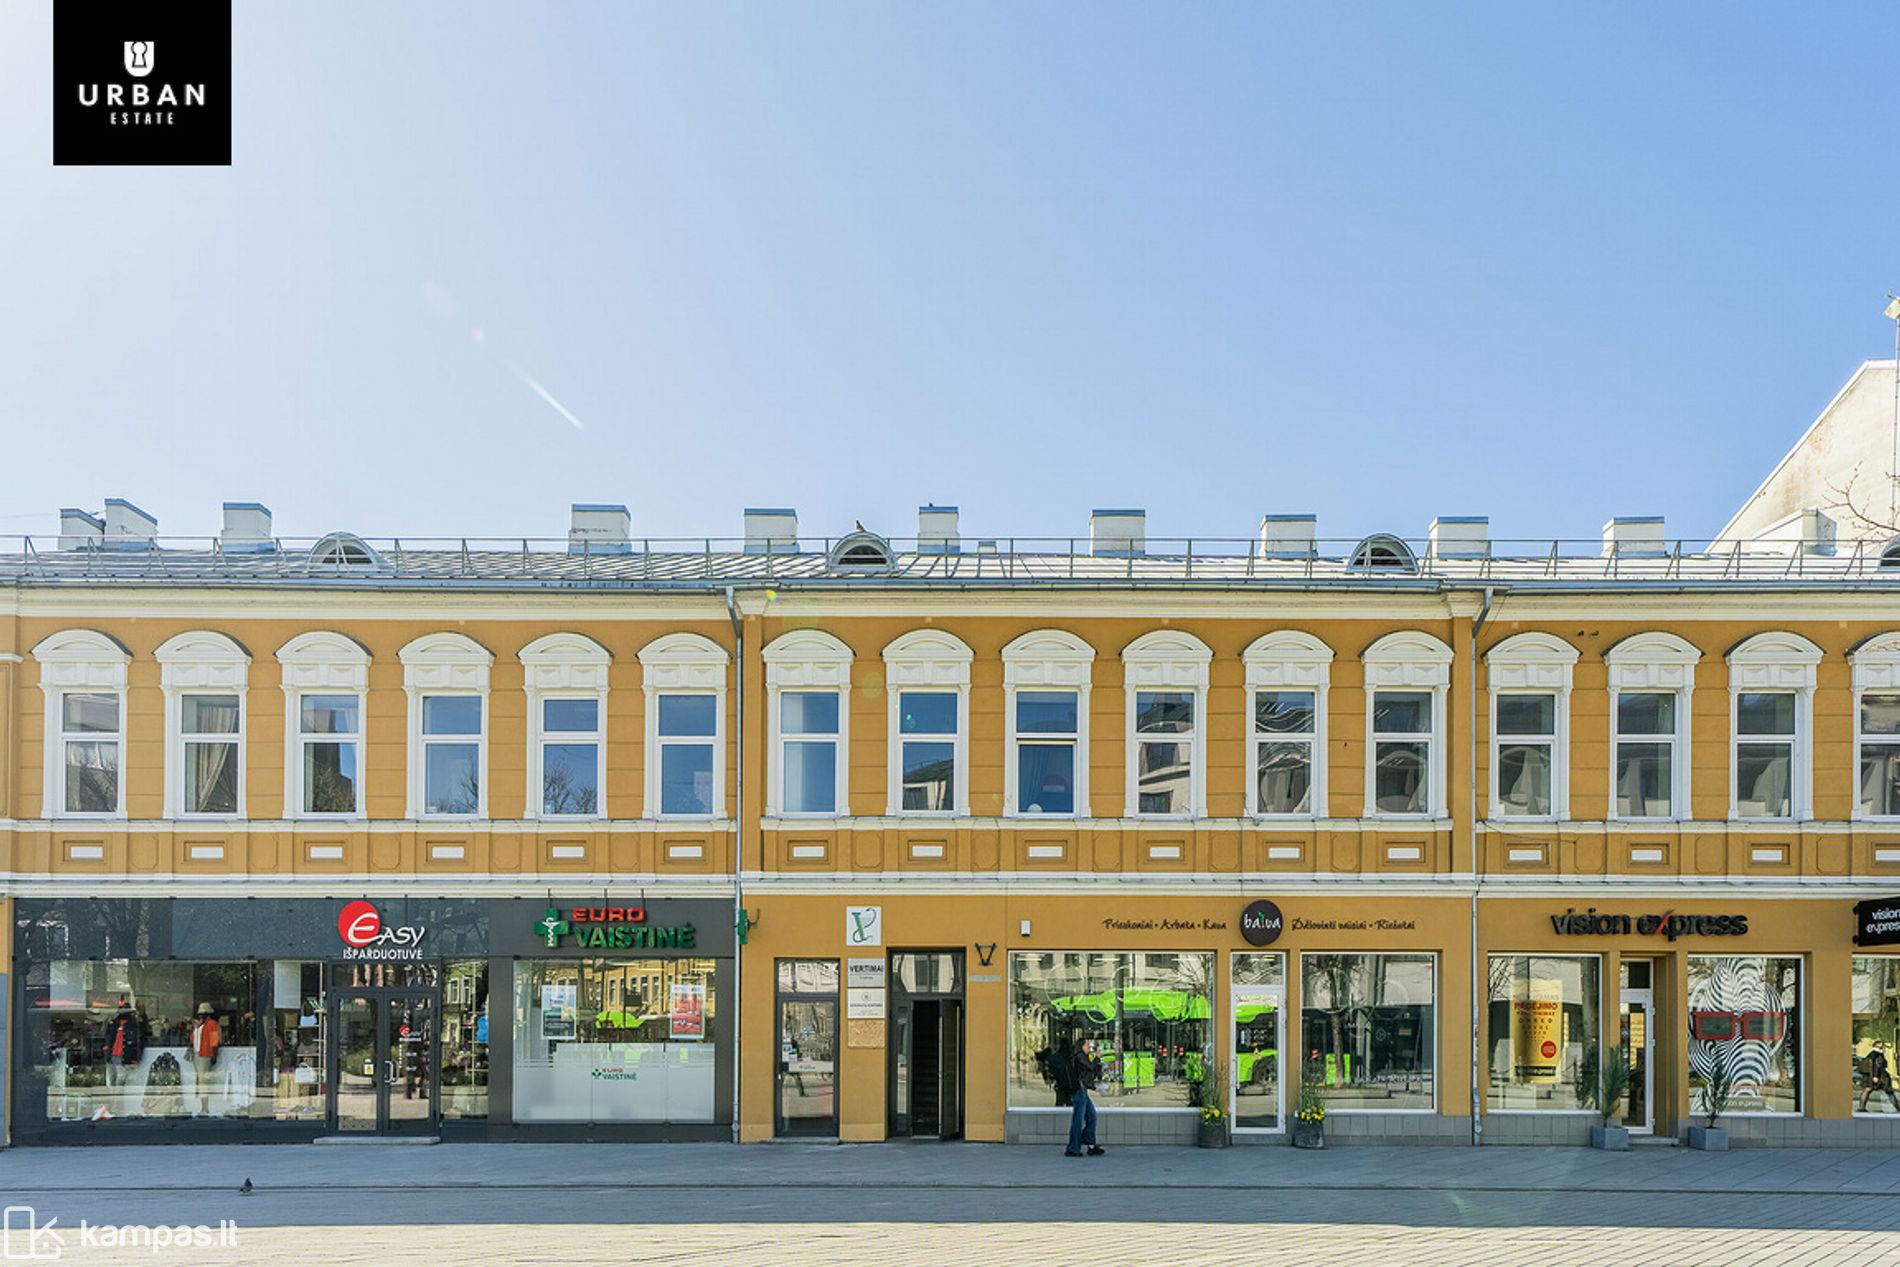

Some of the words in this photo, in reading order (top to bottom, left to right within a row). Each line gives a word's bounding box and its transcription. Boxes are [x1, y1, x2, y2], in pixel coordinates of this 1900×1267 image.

[572, 907, 644, 922] EURO
[1160, 918, 1196, 930] Arbata
[1203, 918, 1226, 930] Kava
[1550, 908, 1631, 935] vision
[1637, 909, 1749, 942] express
[574, 922, 696, 949] VAISTINĖ
[343, 947, 423, 960] IŠPARDUOTUVĖ
